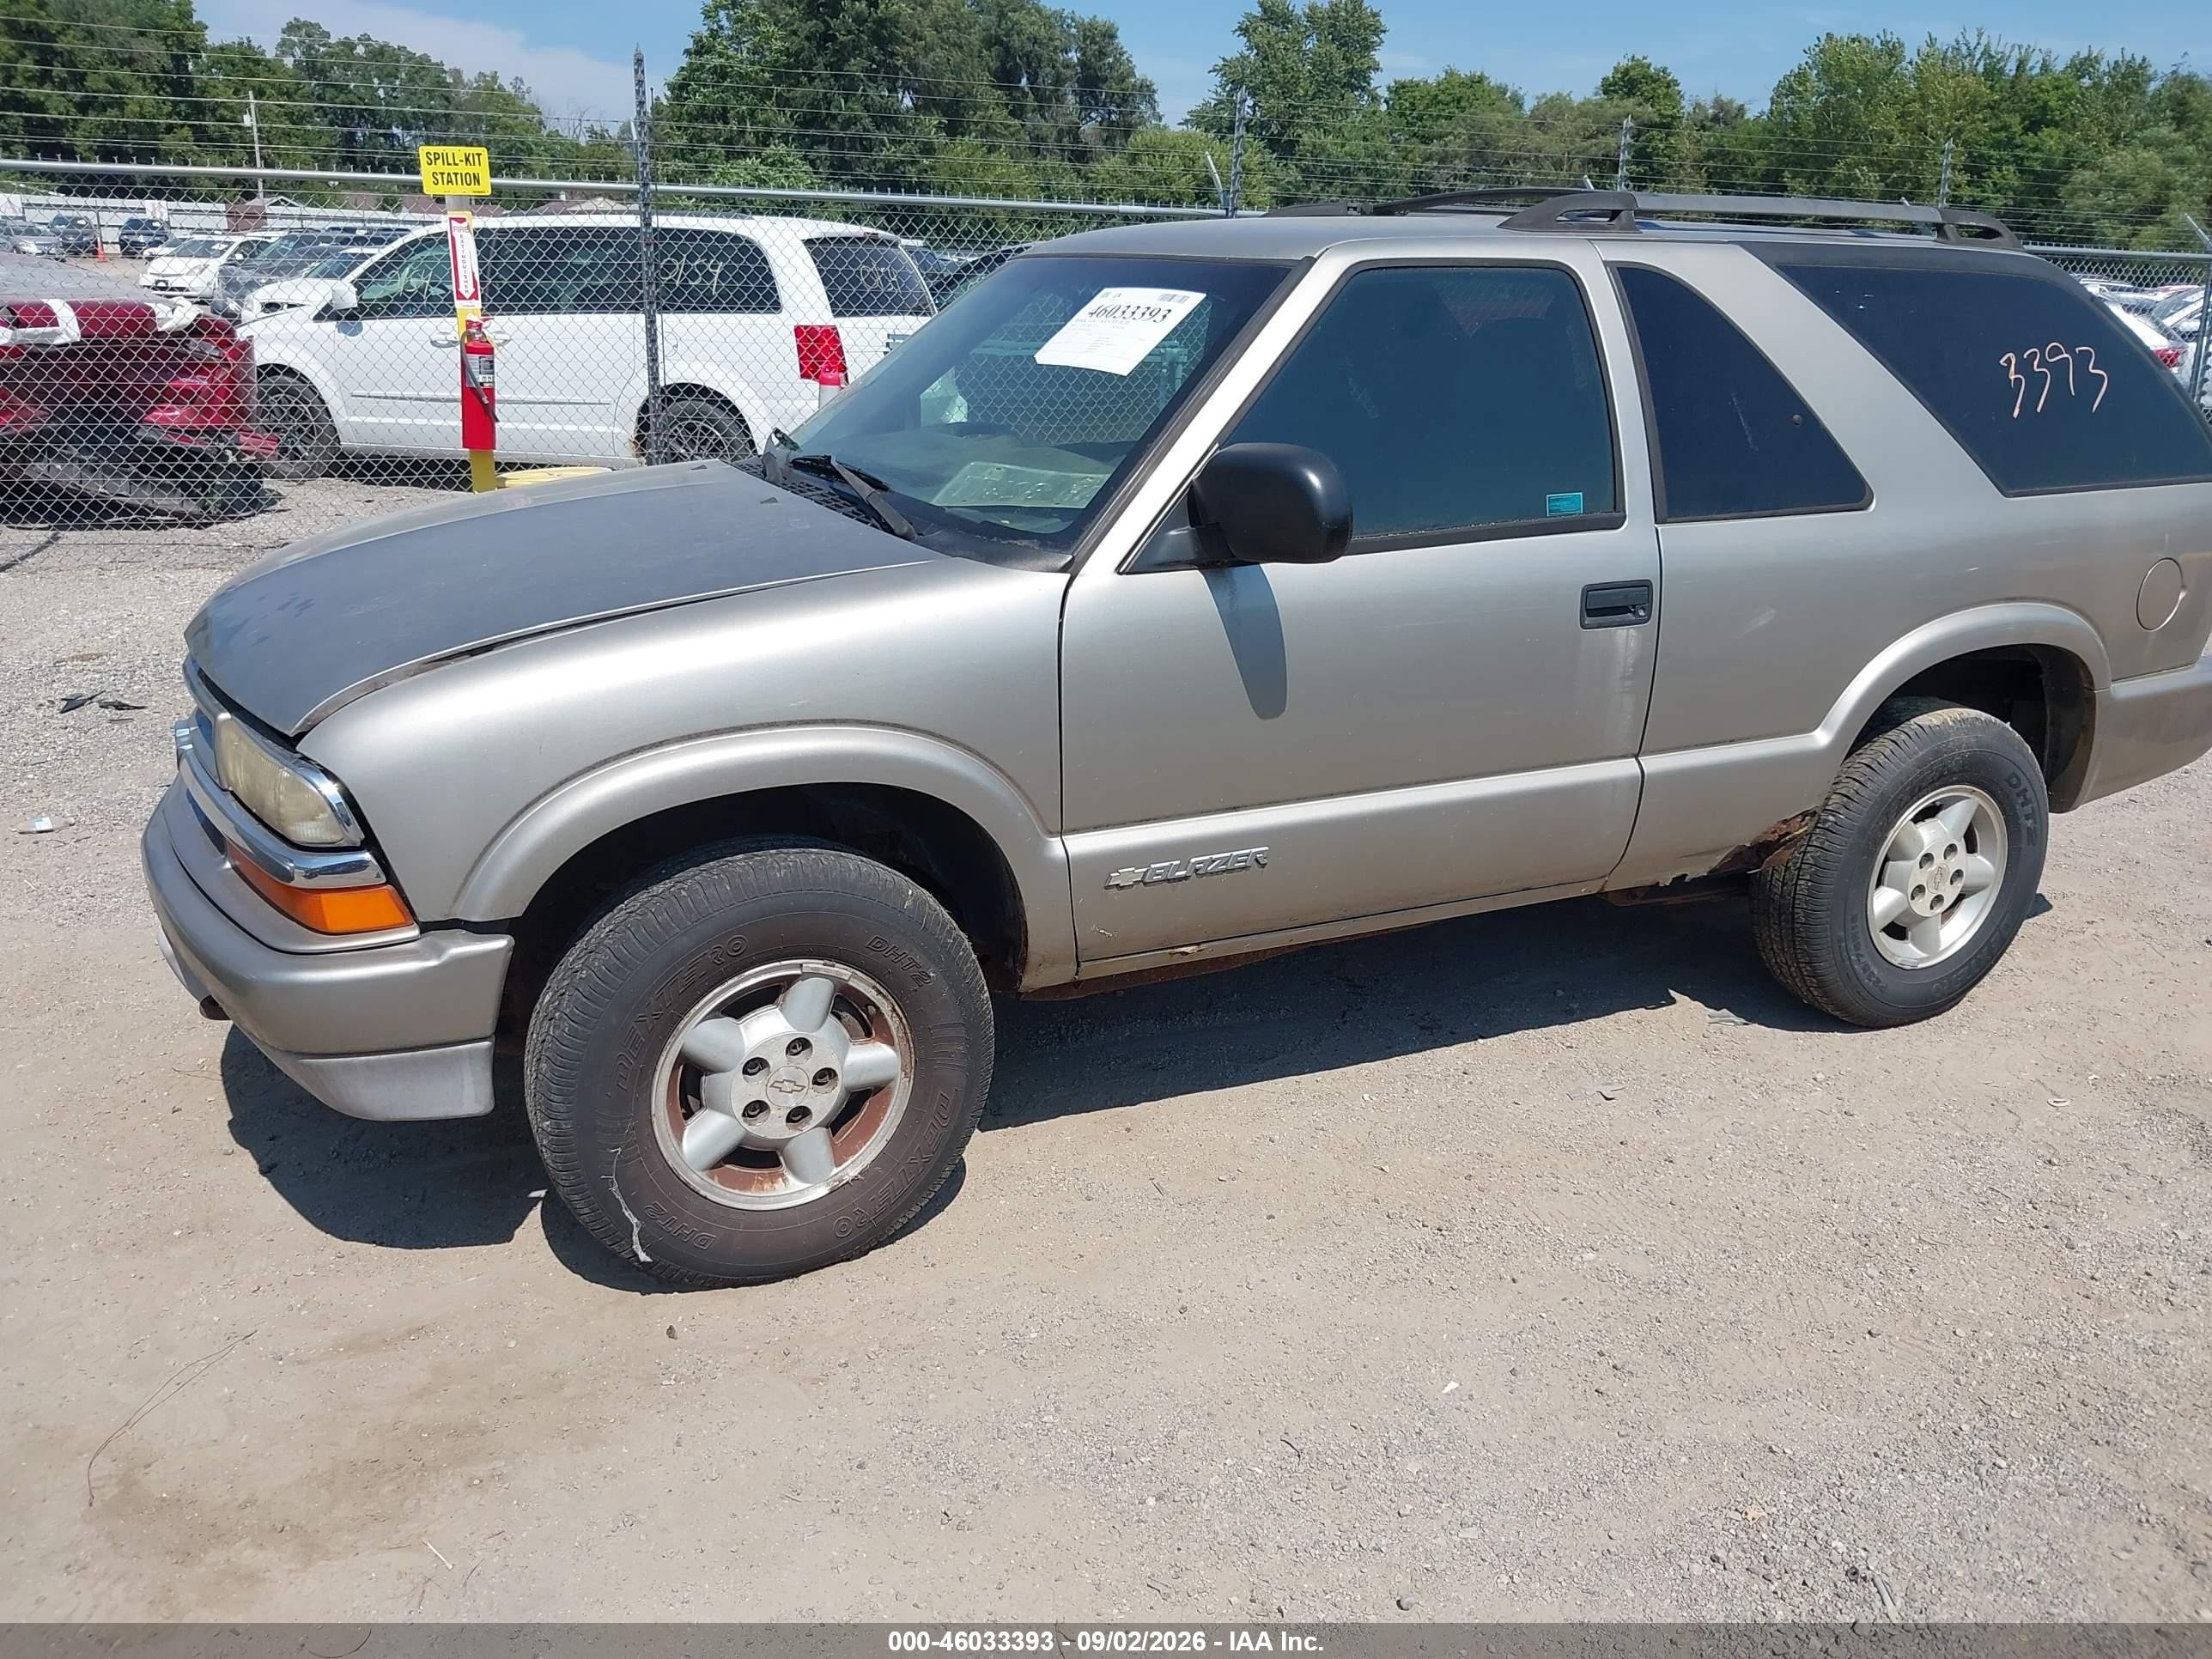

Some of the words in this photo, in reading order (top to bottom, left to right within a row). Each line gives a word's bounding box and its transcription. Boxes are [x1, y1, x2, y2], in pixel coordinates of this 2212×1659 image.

[425, 151, 483, 167] SPILL-KIT
[432, 171, 481, 186] STATION
[1087, 304, 1172, 324] 46033393
[1999, 342, 2109, 419] 3393
[1142, 846, 1270, 885] BLAZER
[865, 934, 934, 988] DHT2
